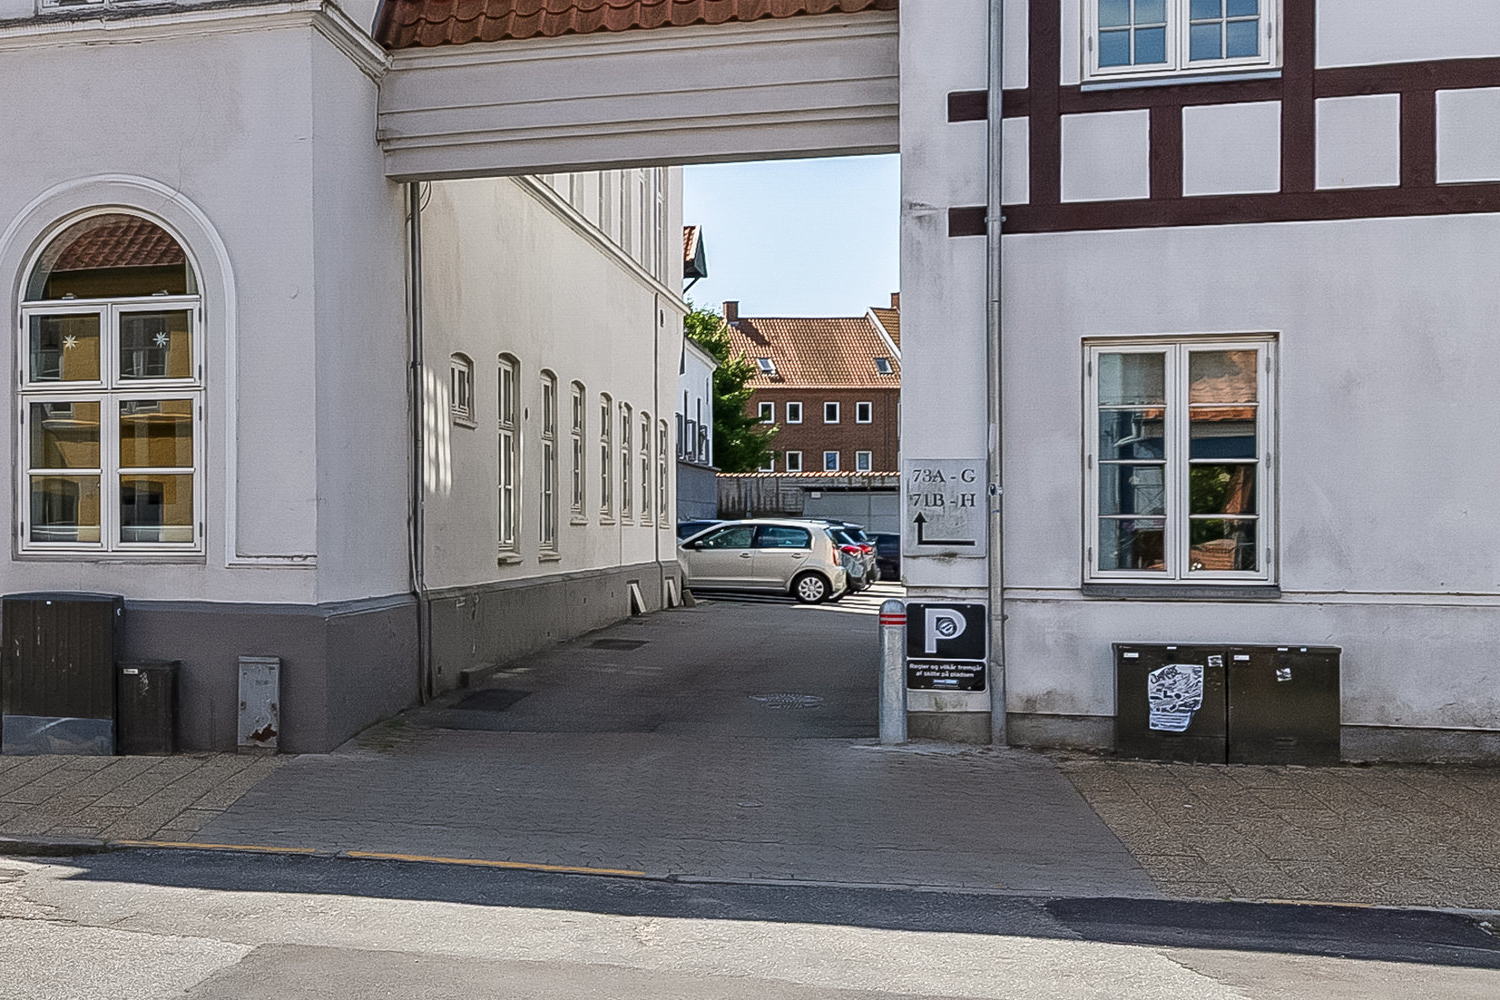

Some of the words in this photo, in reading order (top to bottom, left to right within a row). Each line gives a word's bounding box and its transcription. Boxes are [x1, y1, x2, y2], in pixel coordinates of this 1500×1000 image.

[913, 469, 946, 483] 73A
[961, 468, 976, 483] G
[912, 493, 945, 507] 71B
[960, 493, 976, 507] H
[924, 608, 967, 654] P
